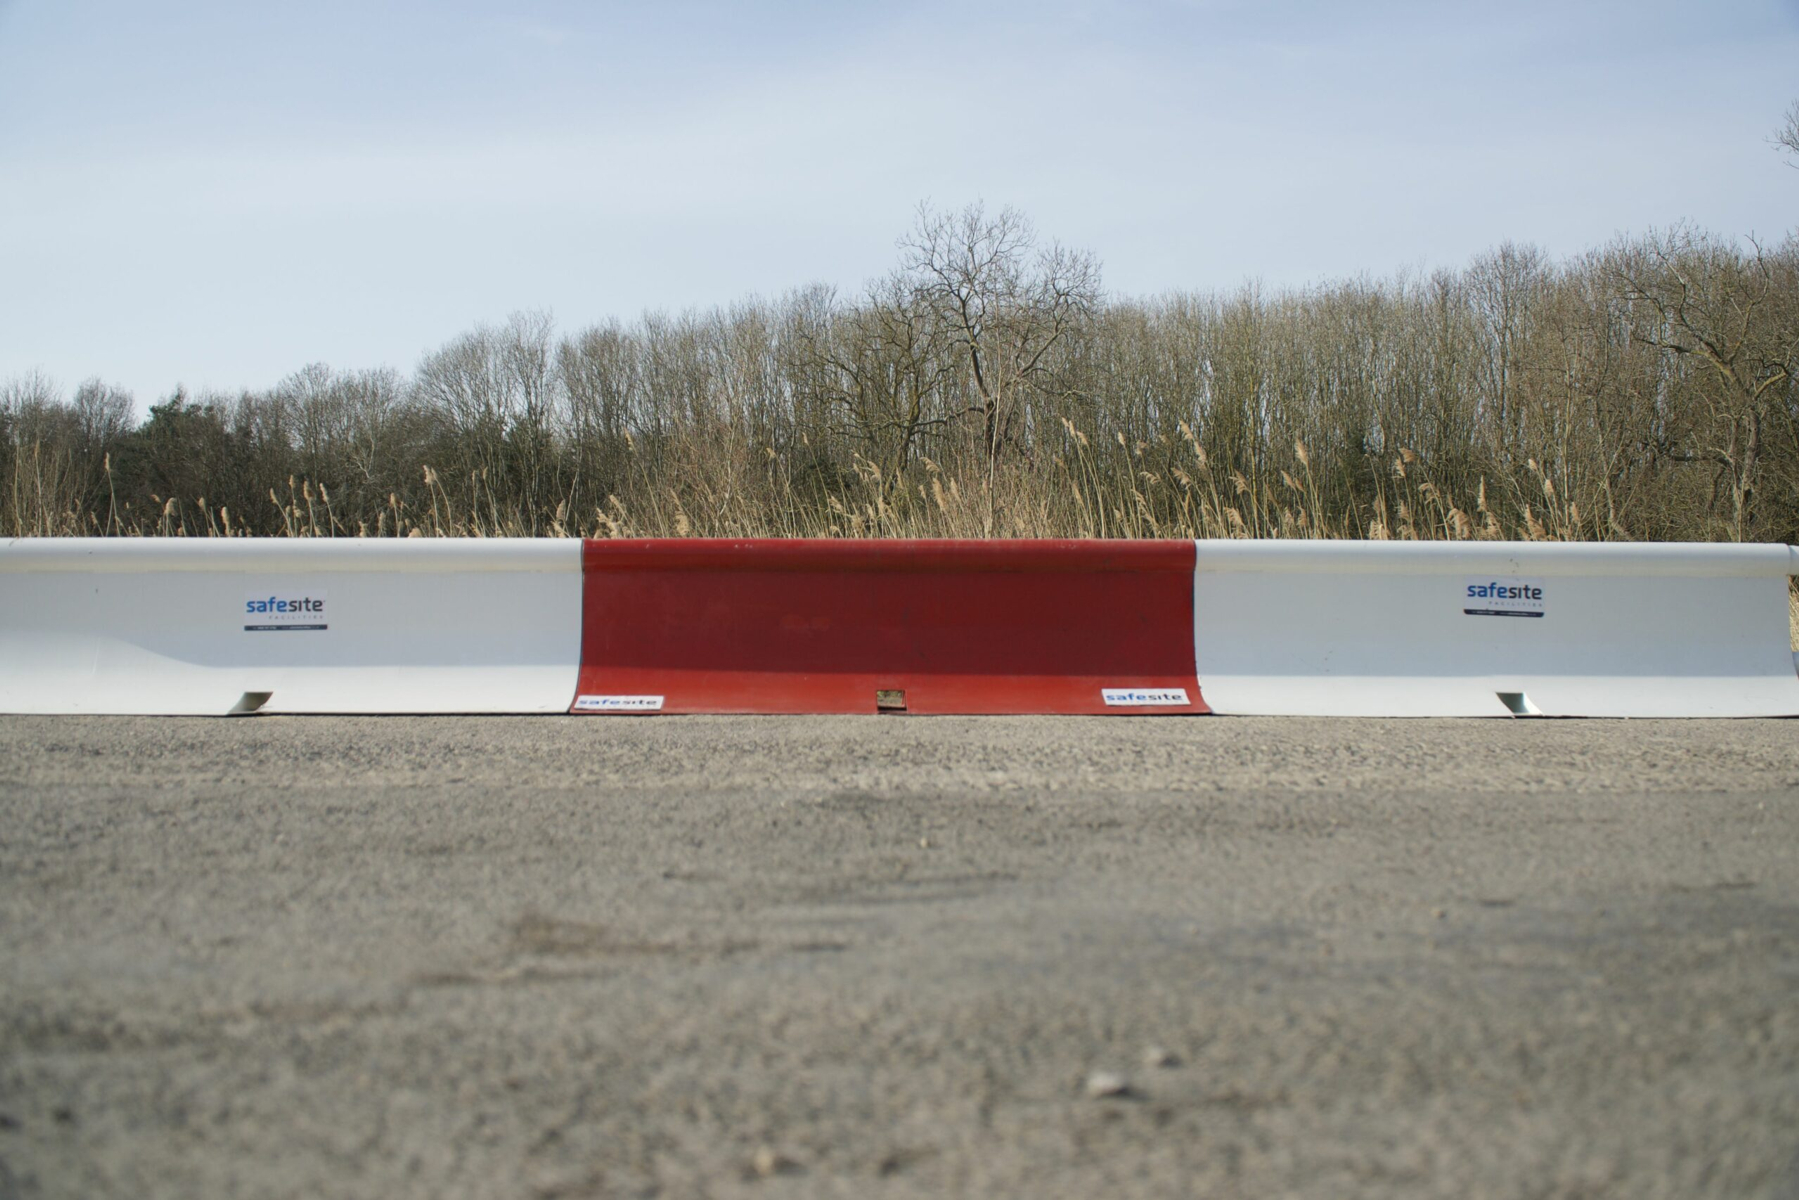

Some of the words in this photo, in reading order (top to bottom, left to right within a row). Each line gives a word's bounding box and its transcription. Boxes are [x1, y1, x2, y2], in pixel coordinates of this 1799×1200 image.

[1467, 582, 1542, 600] safesite
[246, 596, 323, 613] safesite
[1106, 693, 1182, 701] safesite
